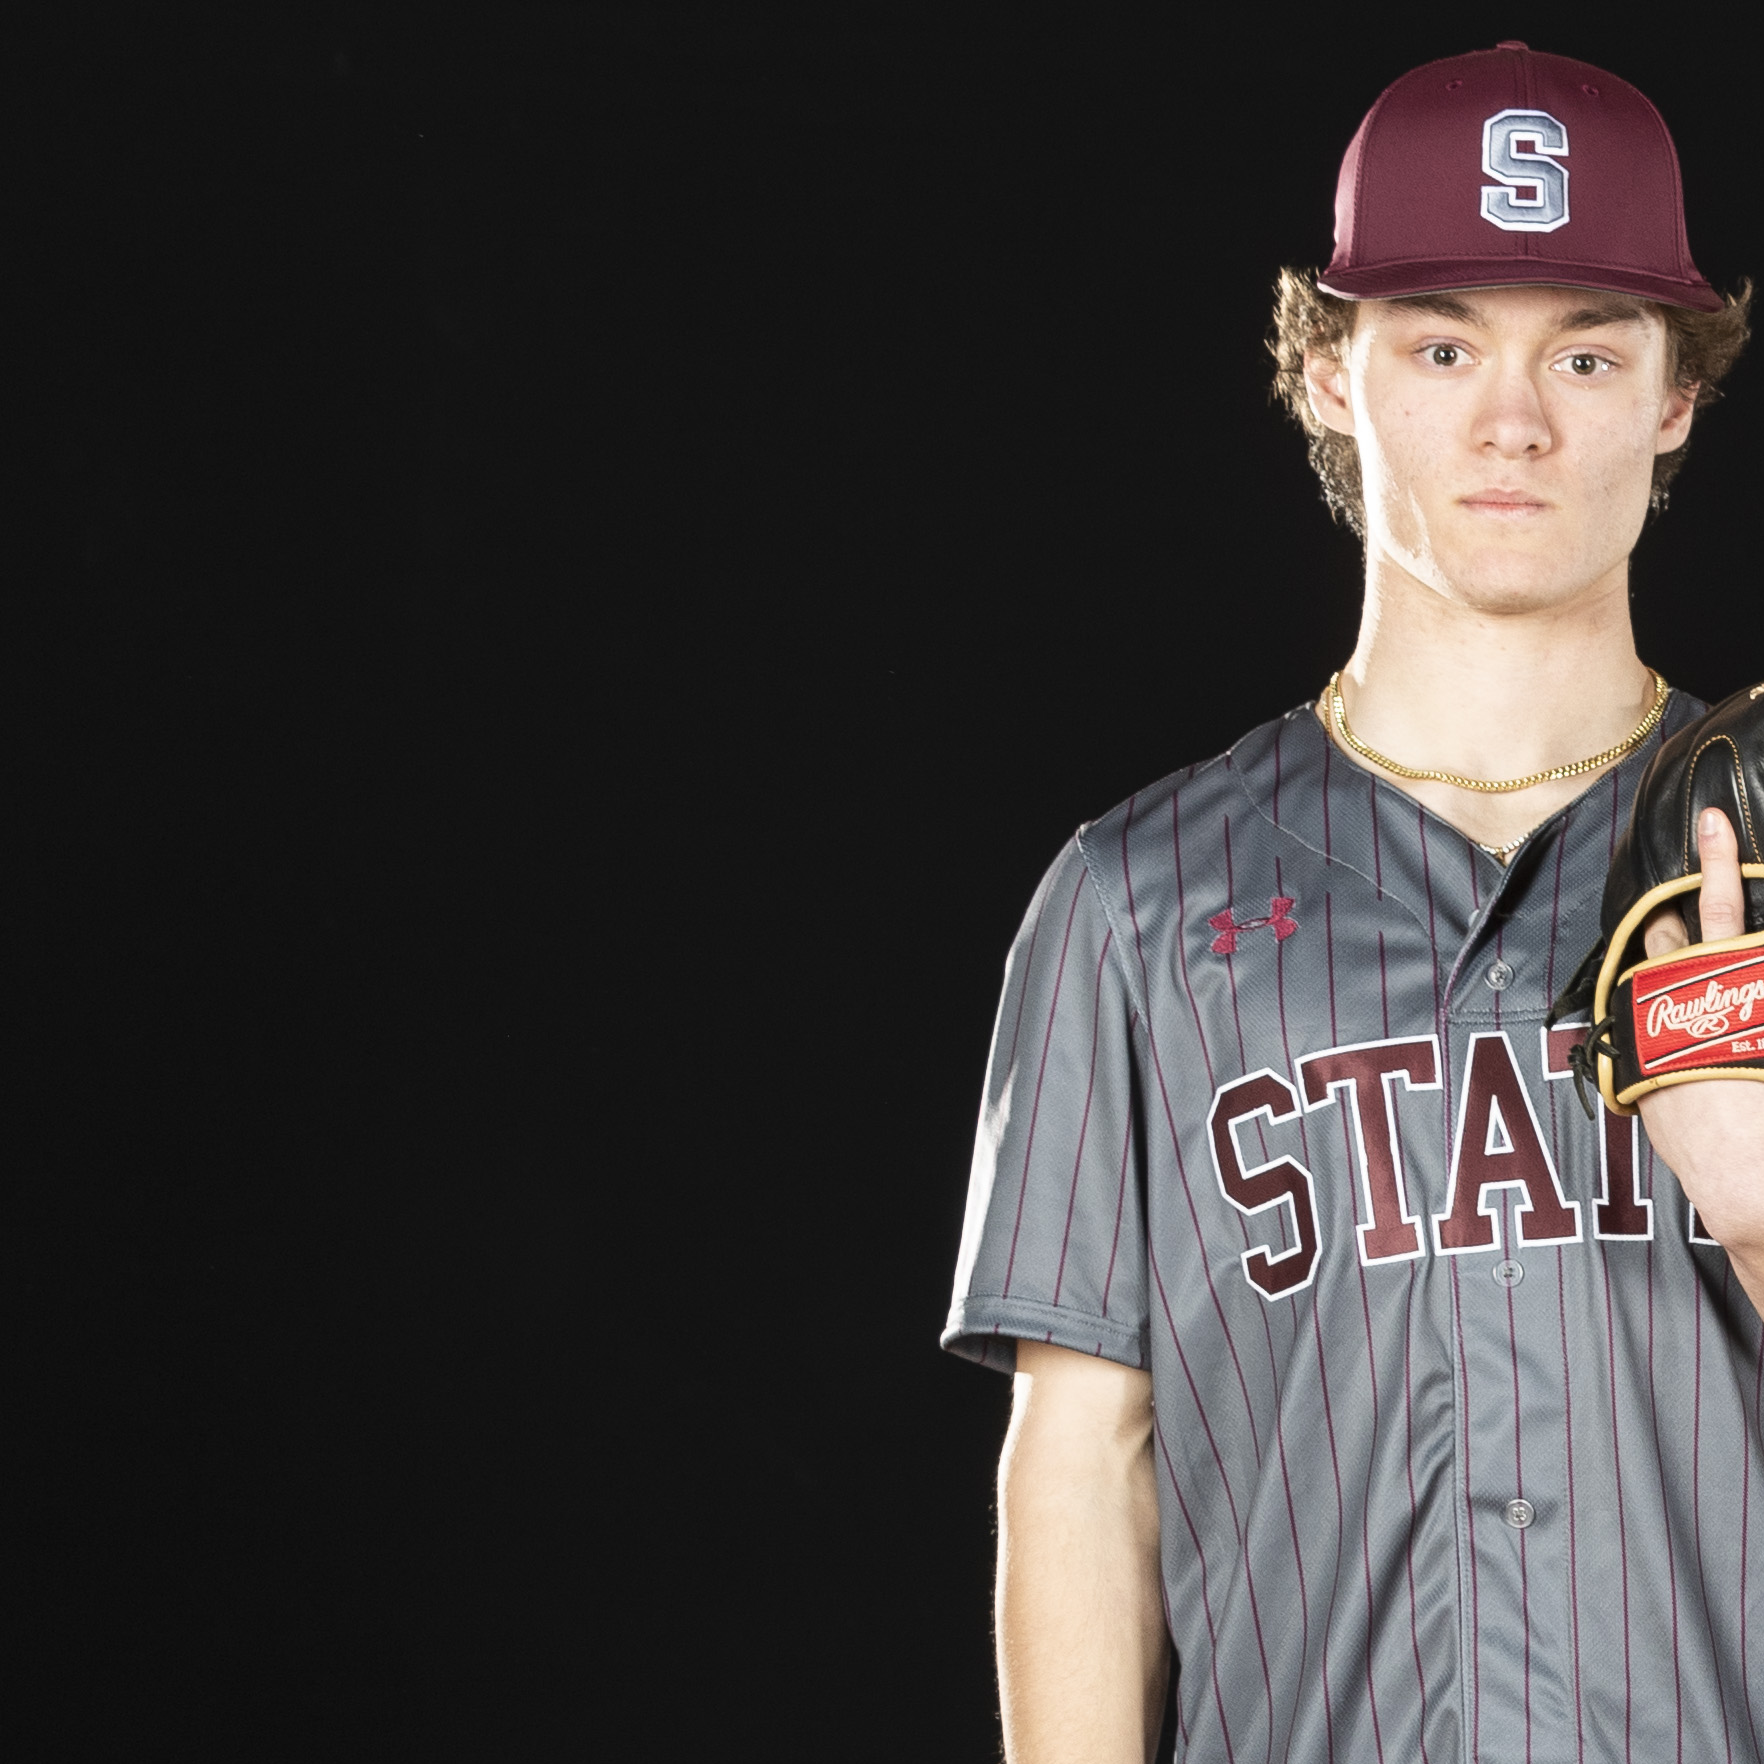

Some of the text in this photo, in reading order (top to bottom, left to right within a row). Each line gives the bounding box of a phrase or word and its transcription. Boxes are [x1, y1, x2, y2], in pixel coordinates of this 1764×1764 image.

[1480, 109, 1570, 233] S
[1731, 1039, 1756, 1054] Est.
[1206, 1022, 1722, 1304] STAT
